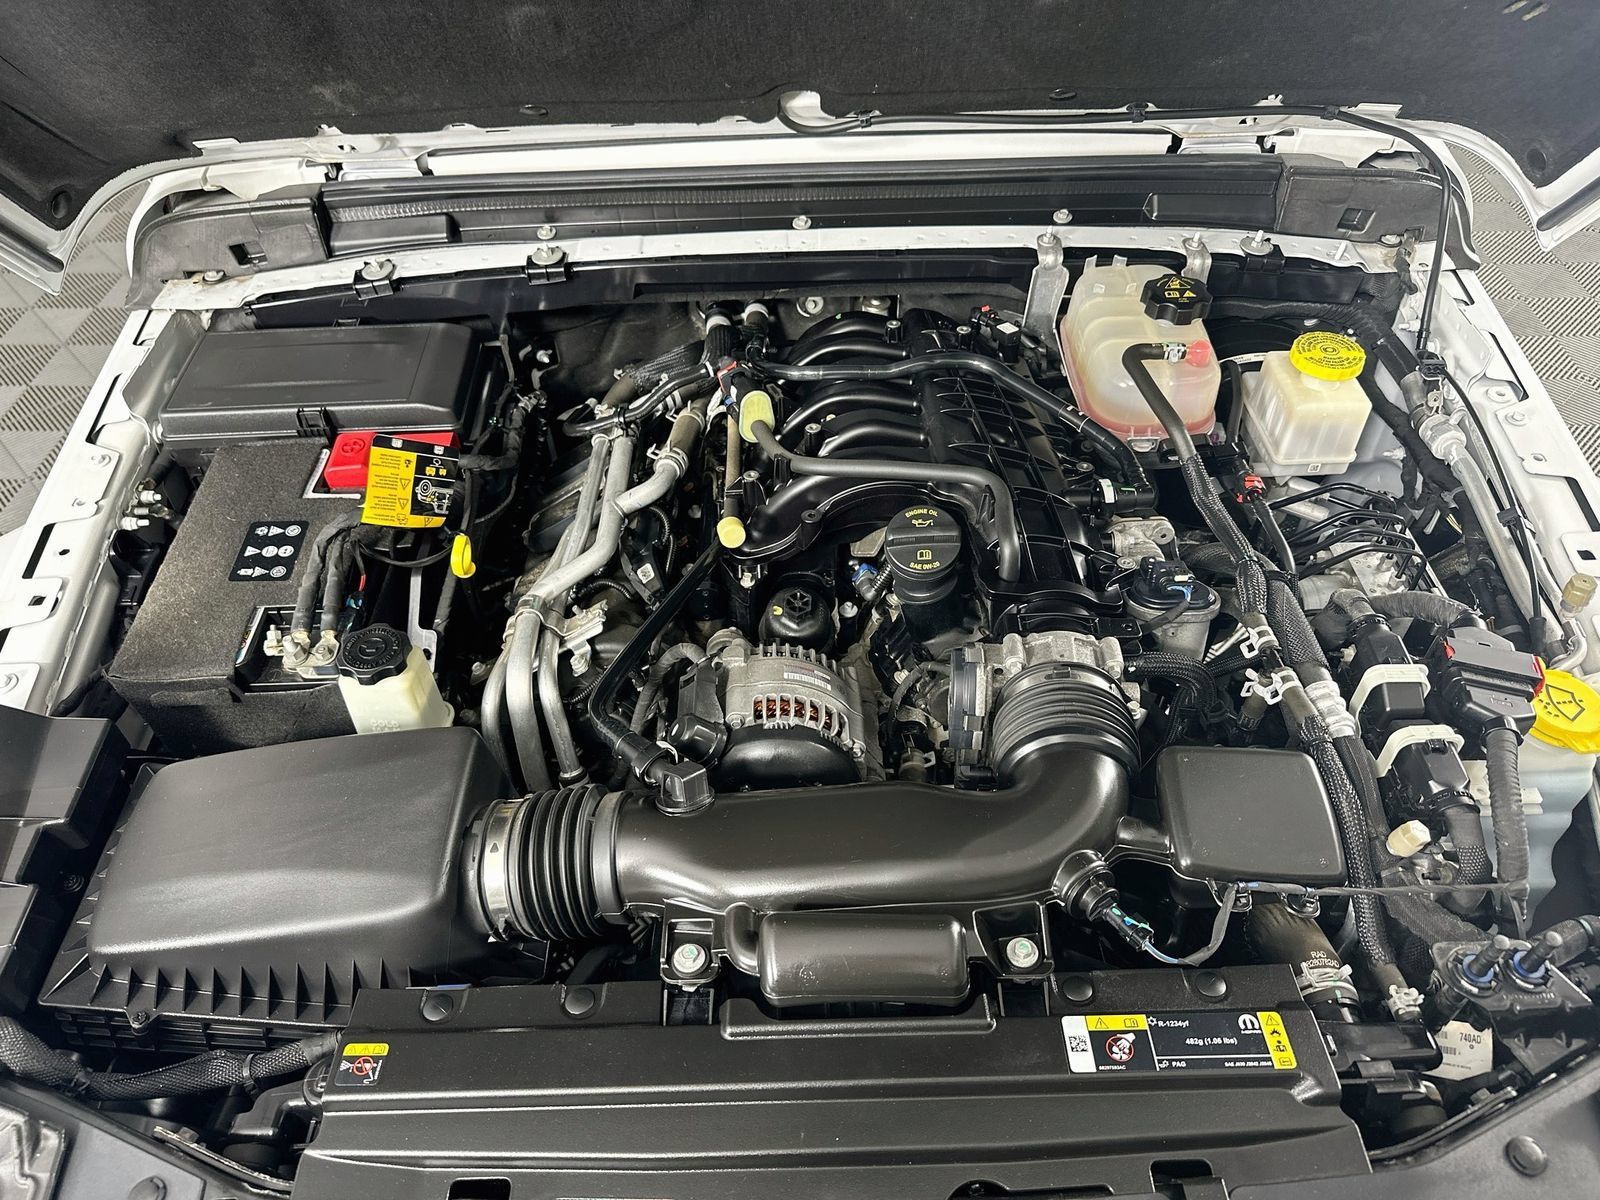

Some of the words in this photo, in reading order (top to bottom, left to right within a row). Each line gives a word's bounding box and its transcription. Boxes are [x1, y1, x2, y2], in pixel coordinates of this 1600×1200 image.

[905, 508, 928, 518] ENGINE
[928, 509, 938, 517] OIL
[909, 561, 922, 569] SAE
[922, 561, 940, 570] 0W-20
[369, 719, 400, 728] COLD
[1223, 1037, 1238, 1045] lbs)
[1459, 1032, 1481, 1043] 740AD
